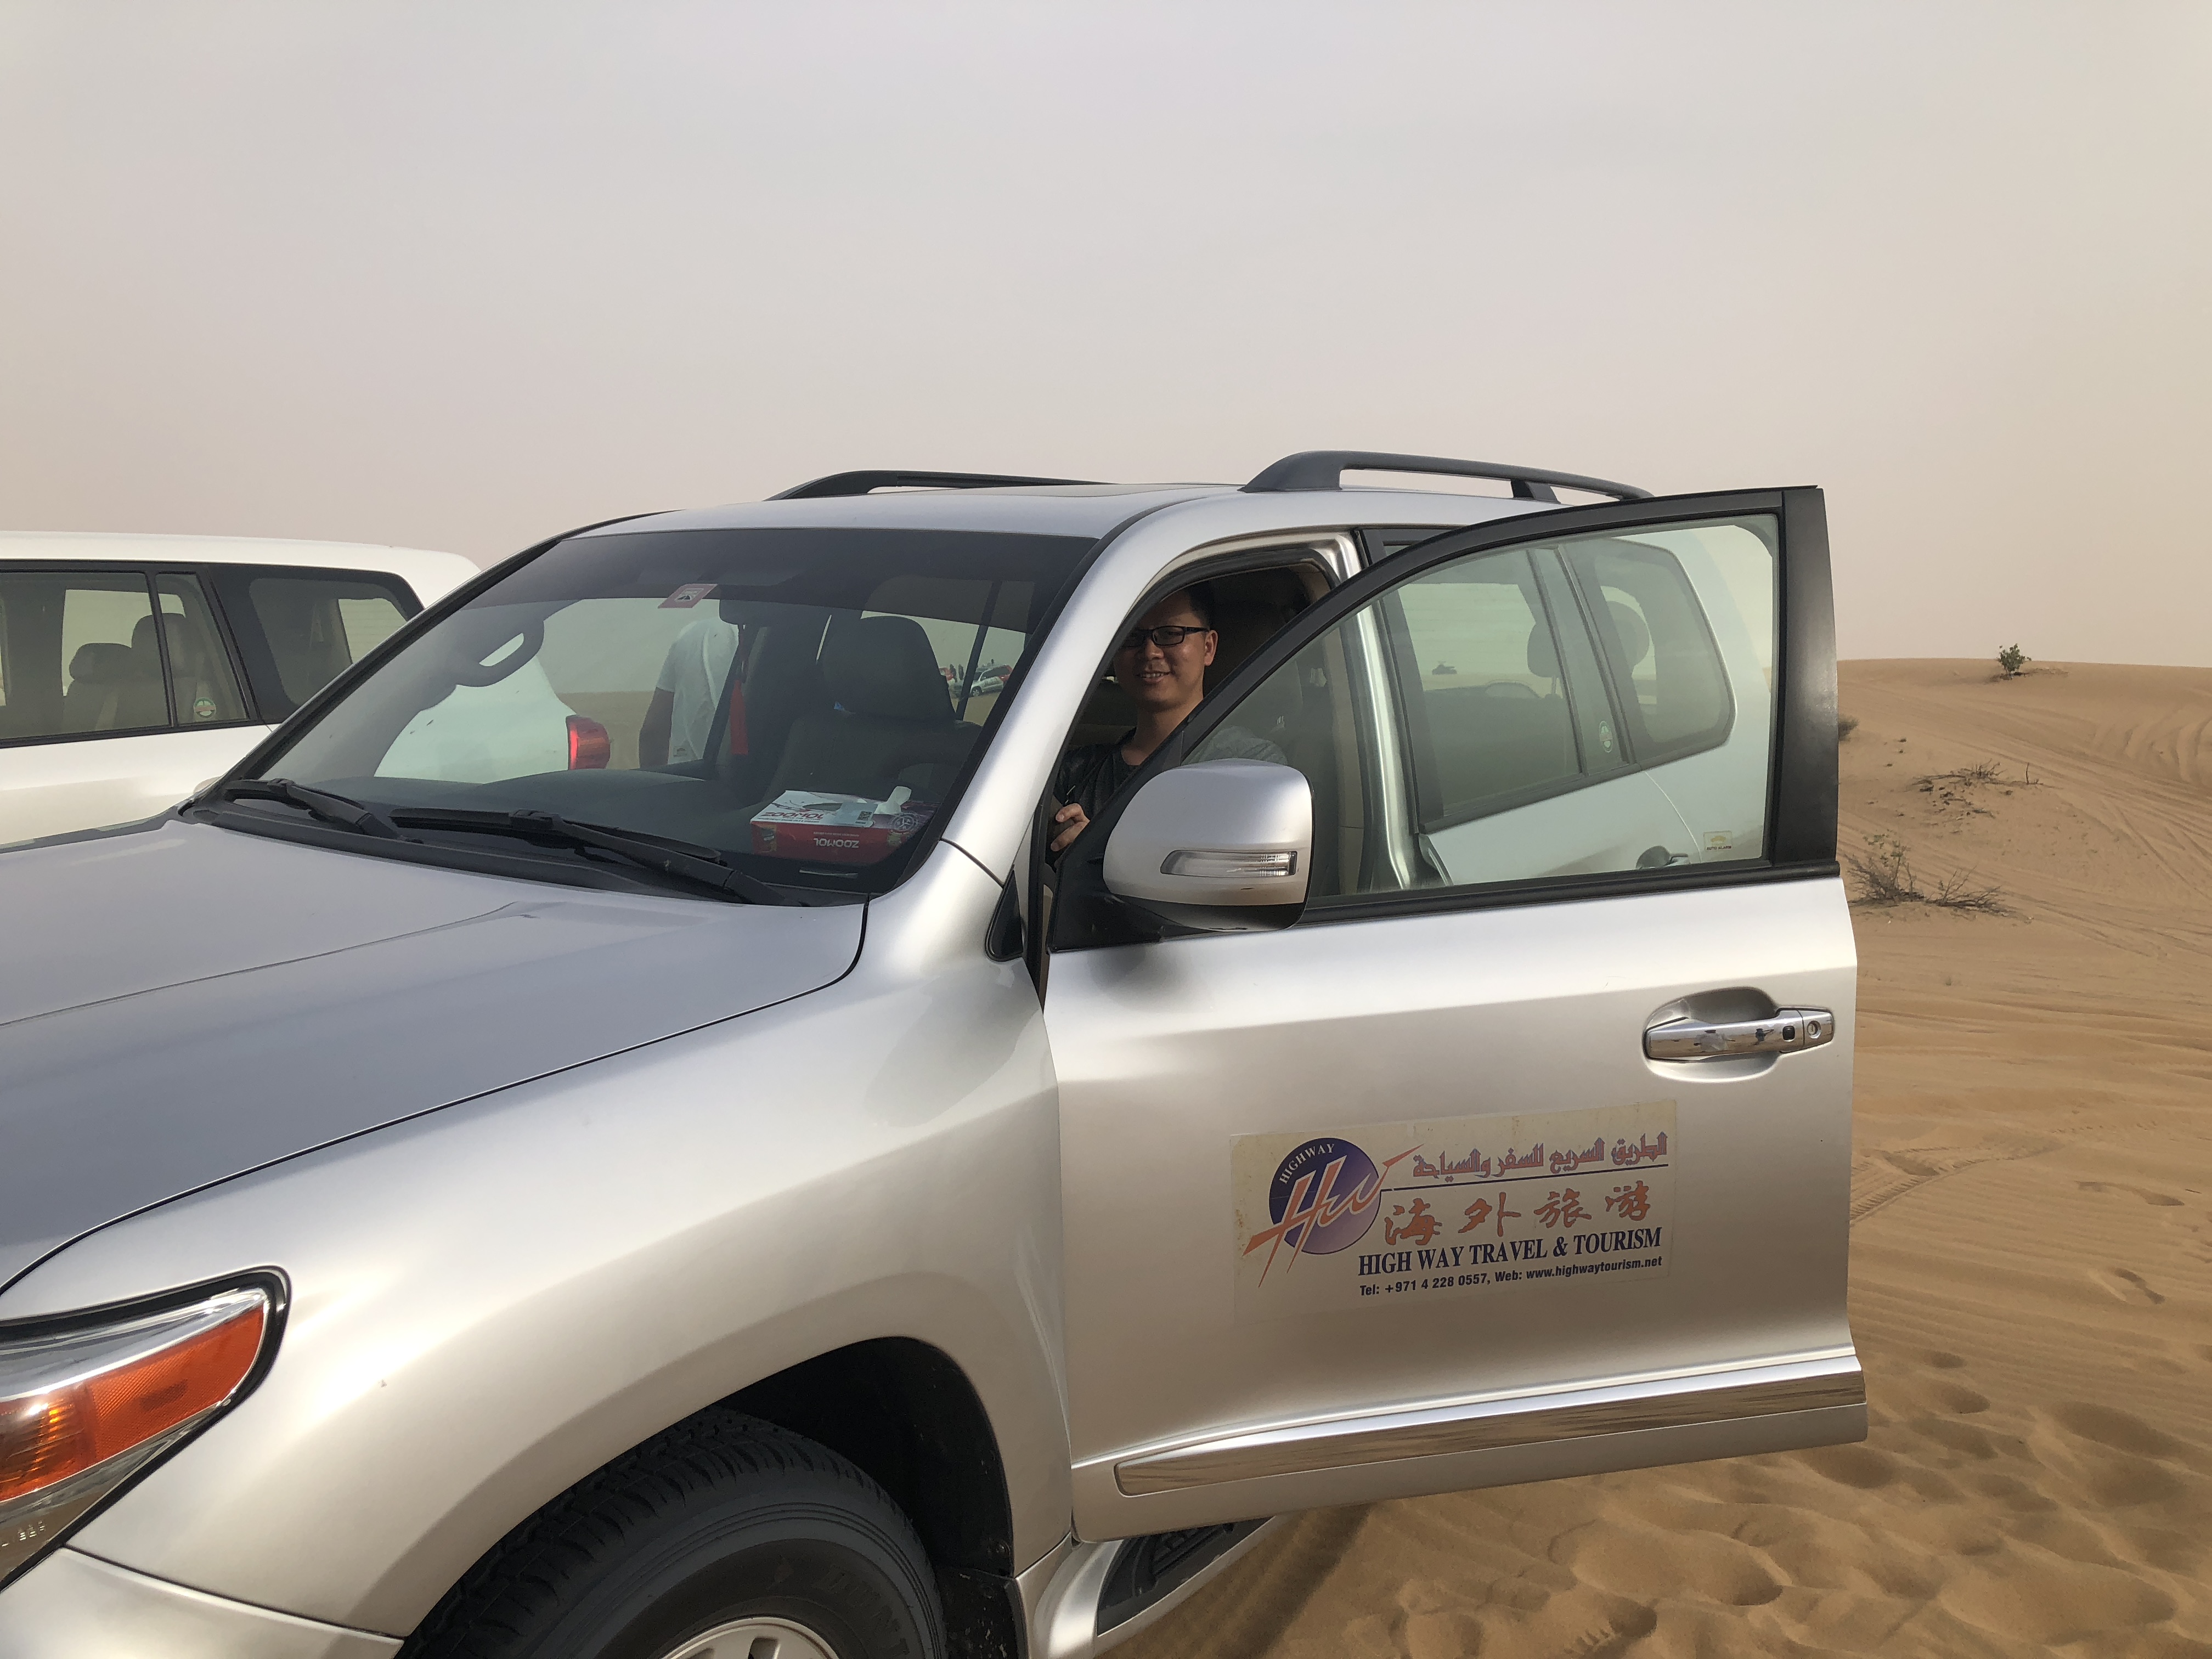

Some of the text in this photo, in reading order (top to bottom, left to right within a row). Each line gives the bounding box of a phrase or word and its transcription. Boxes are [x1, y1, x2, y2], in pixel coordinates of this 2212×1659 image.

[1279, 1143, 1335, 1184] HIGHWAY
[1413, 1131, 1668, 1182] الطريق السريع للسفر والسياحة
[1358, 1227, 1663, 1276] HIGH WAY TRAVEL & TOURISM
[1360, 1256, 1663, 1296] Tel: +971 4 228 0557, Web: www.highwaytourism.net
